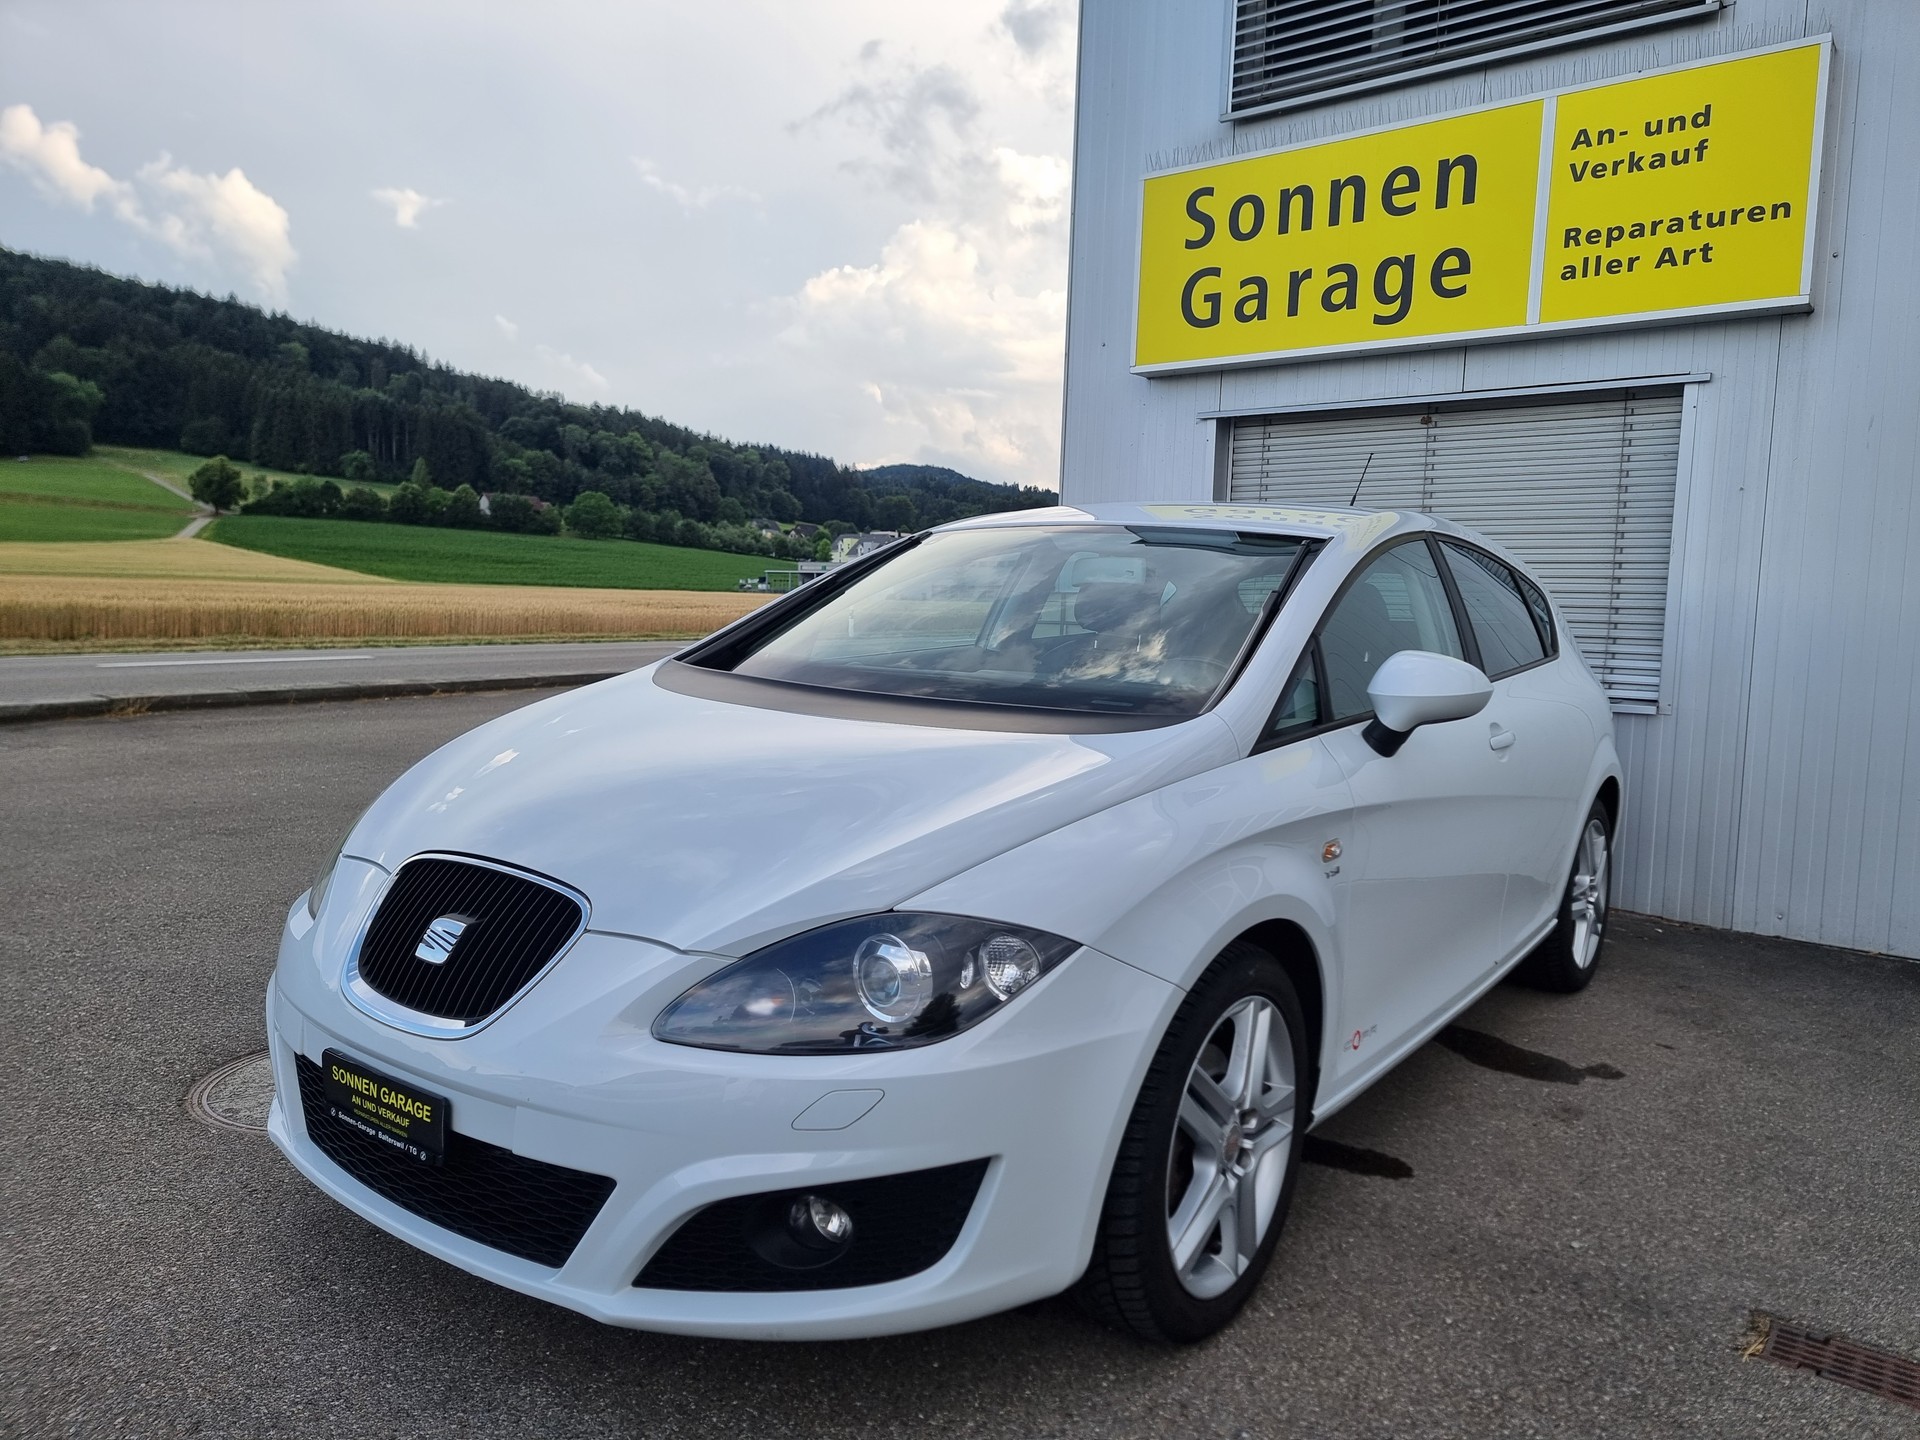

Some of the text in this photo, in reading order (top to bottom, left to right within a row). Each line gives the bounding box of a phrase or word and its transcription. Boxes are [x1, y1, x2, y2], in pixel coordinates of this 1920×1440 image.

[1570, 103, 1712, 151] An- und
[1569, 138, 1709, 184] Verkauf
[1184, 154, 1478, 250] Sonnen
[1563, 201, 1792, 249] Reparaturen
[1560, 241, 1714, 281] aller Art
[1180, 247, 1471, 329] Garage
[332, 1065, 378, 1099] SONNEN
[380, 1087, 432, 1123] GARAGE
[352, 1094, 361, 1106] AN
[362, 1098, 377, 1113] UND
[377, 1105, 410, 1128] VERKAUF
